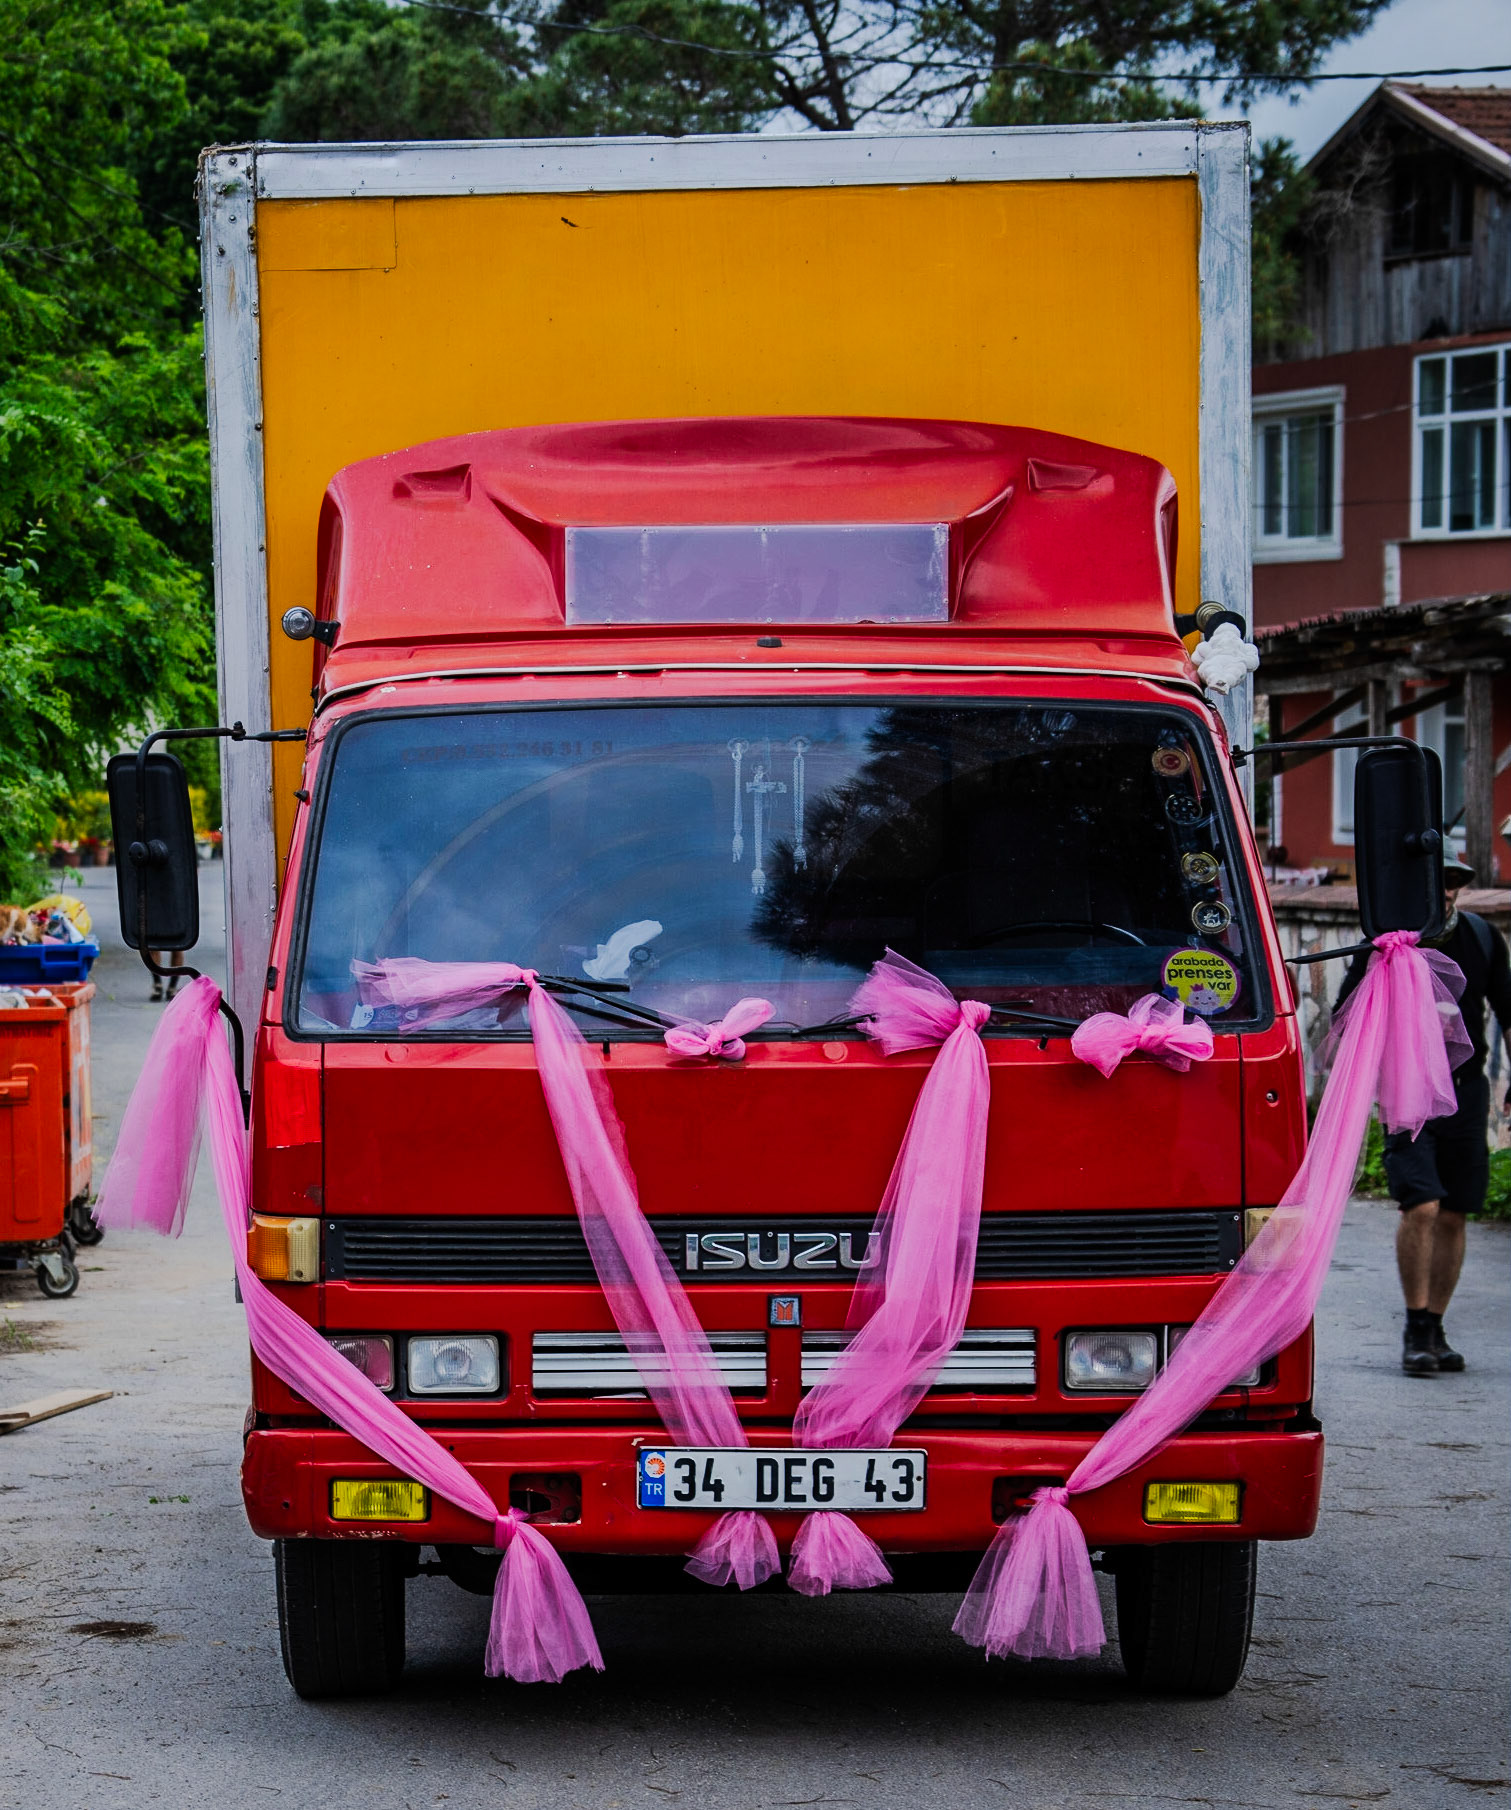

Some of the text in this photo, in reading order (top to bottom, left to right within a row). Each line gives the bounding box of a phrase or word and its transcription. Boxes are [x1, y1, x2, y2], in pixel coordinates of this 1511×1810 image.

[1171, 957, 1225, 967] arabada
[1167, 968, 1233, 981] prenses
[1208, 981, 1232, 991] var
[686, 1232, 881, 1271] ISUZU
[645, 1457, 914, 1503] TR 34 DEG 43
